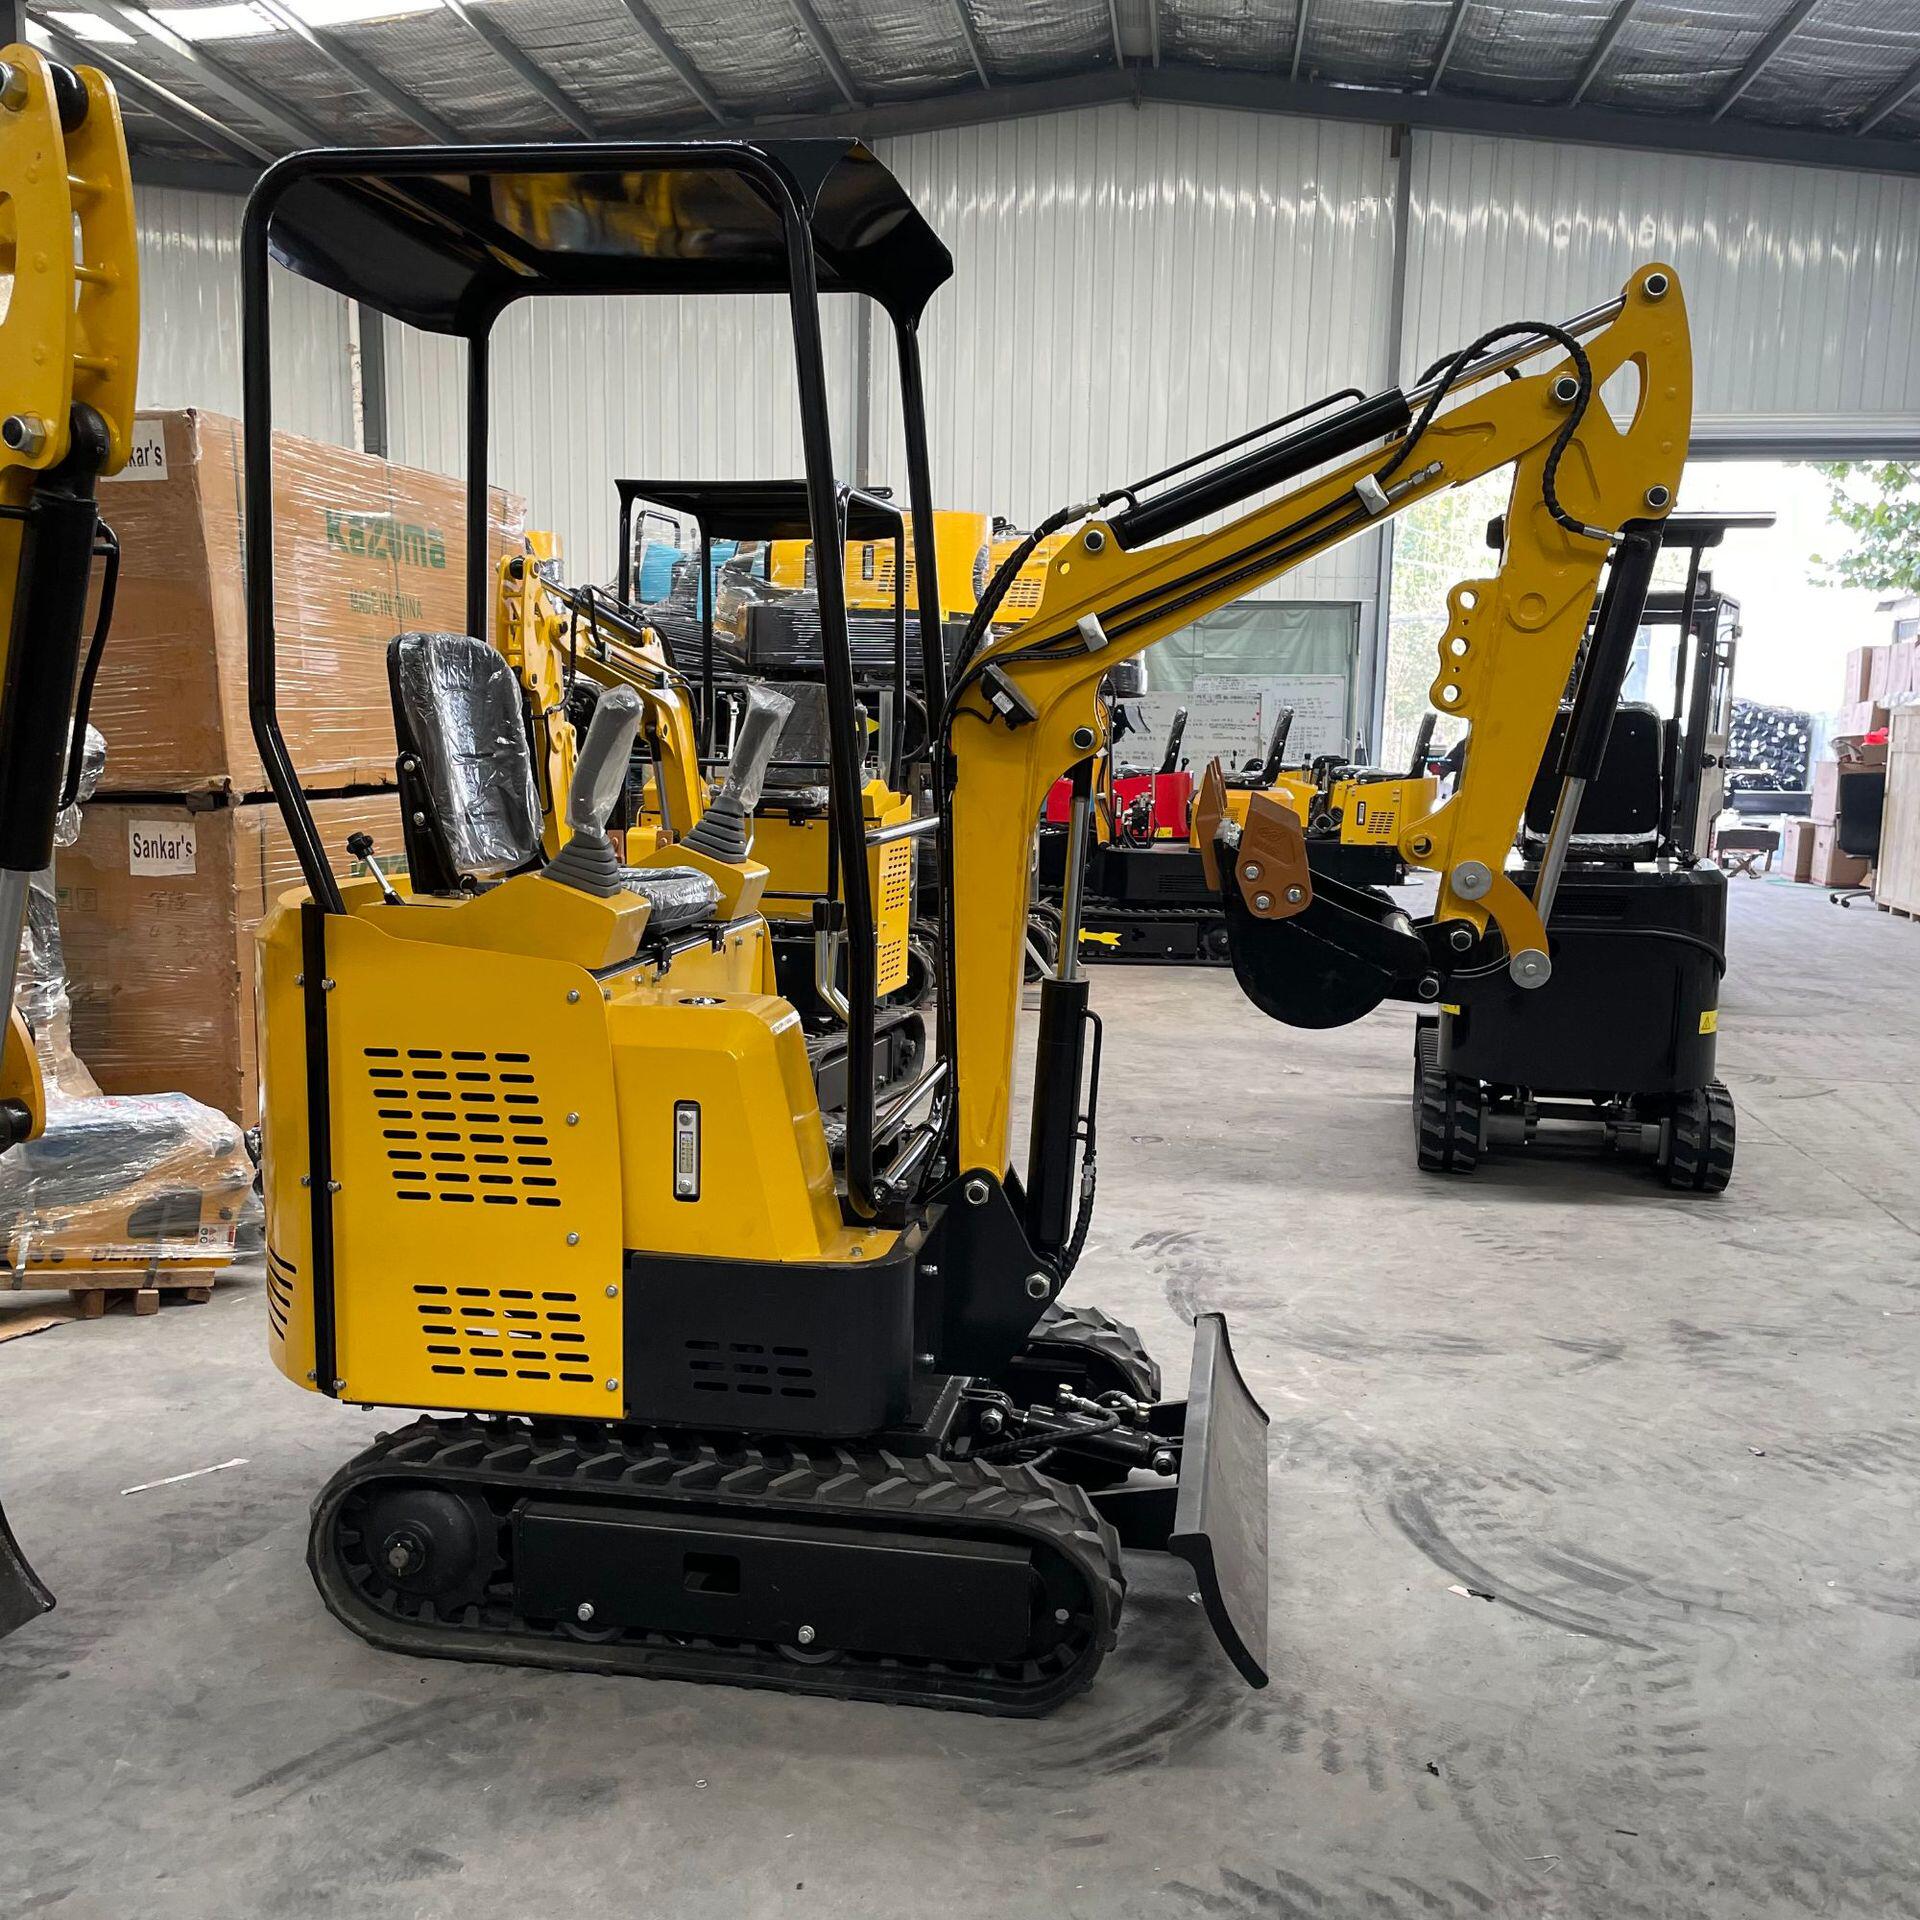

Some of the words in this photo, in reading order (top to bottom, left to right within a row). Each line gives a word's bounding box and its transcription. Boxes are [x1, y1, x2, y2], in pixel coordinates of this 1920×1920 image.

[127, 439, 163, 467] kar's
[348, 588, 378, 616] MADE
[379, 591, 393, 617] IN
[394, 593, 423, 619] CHINA
[133, 832, 193, 859] Sankar's
